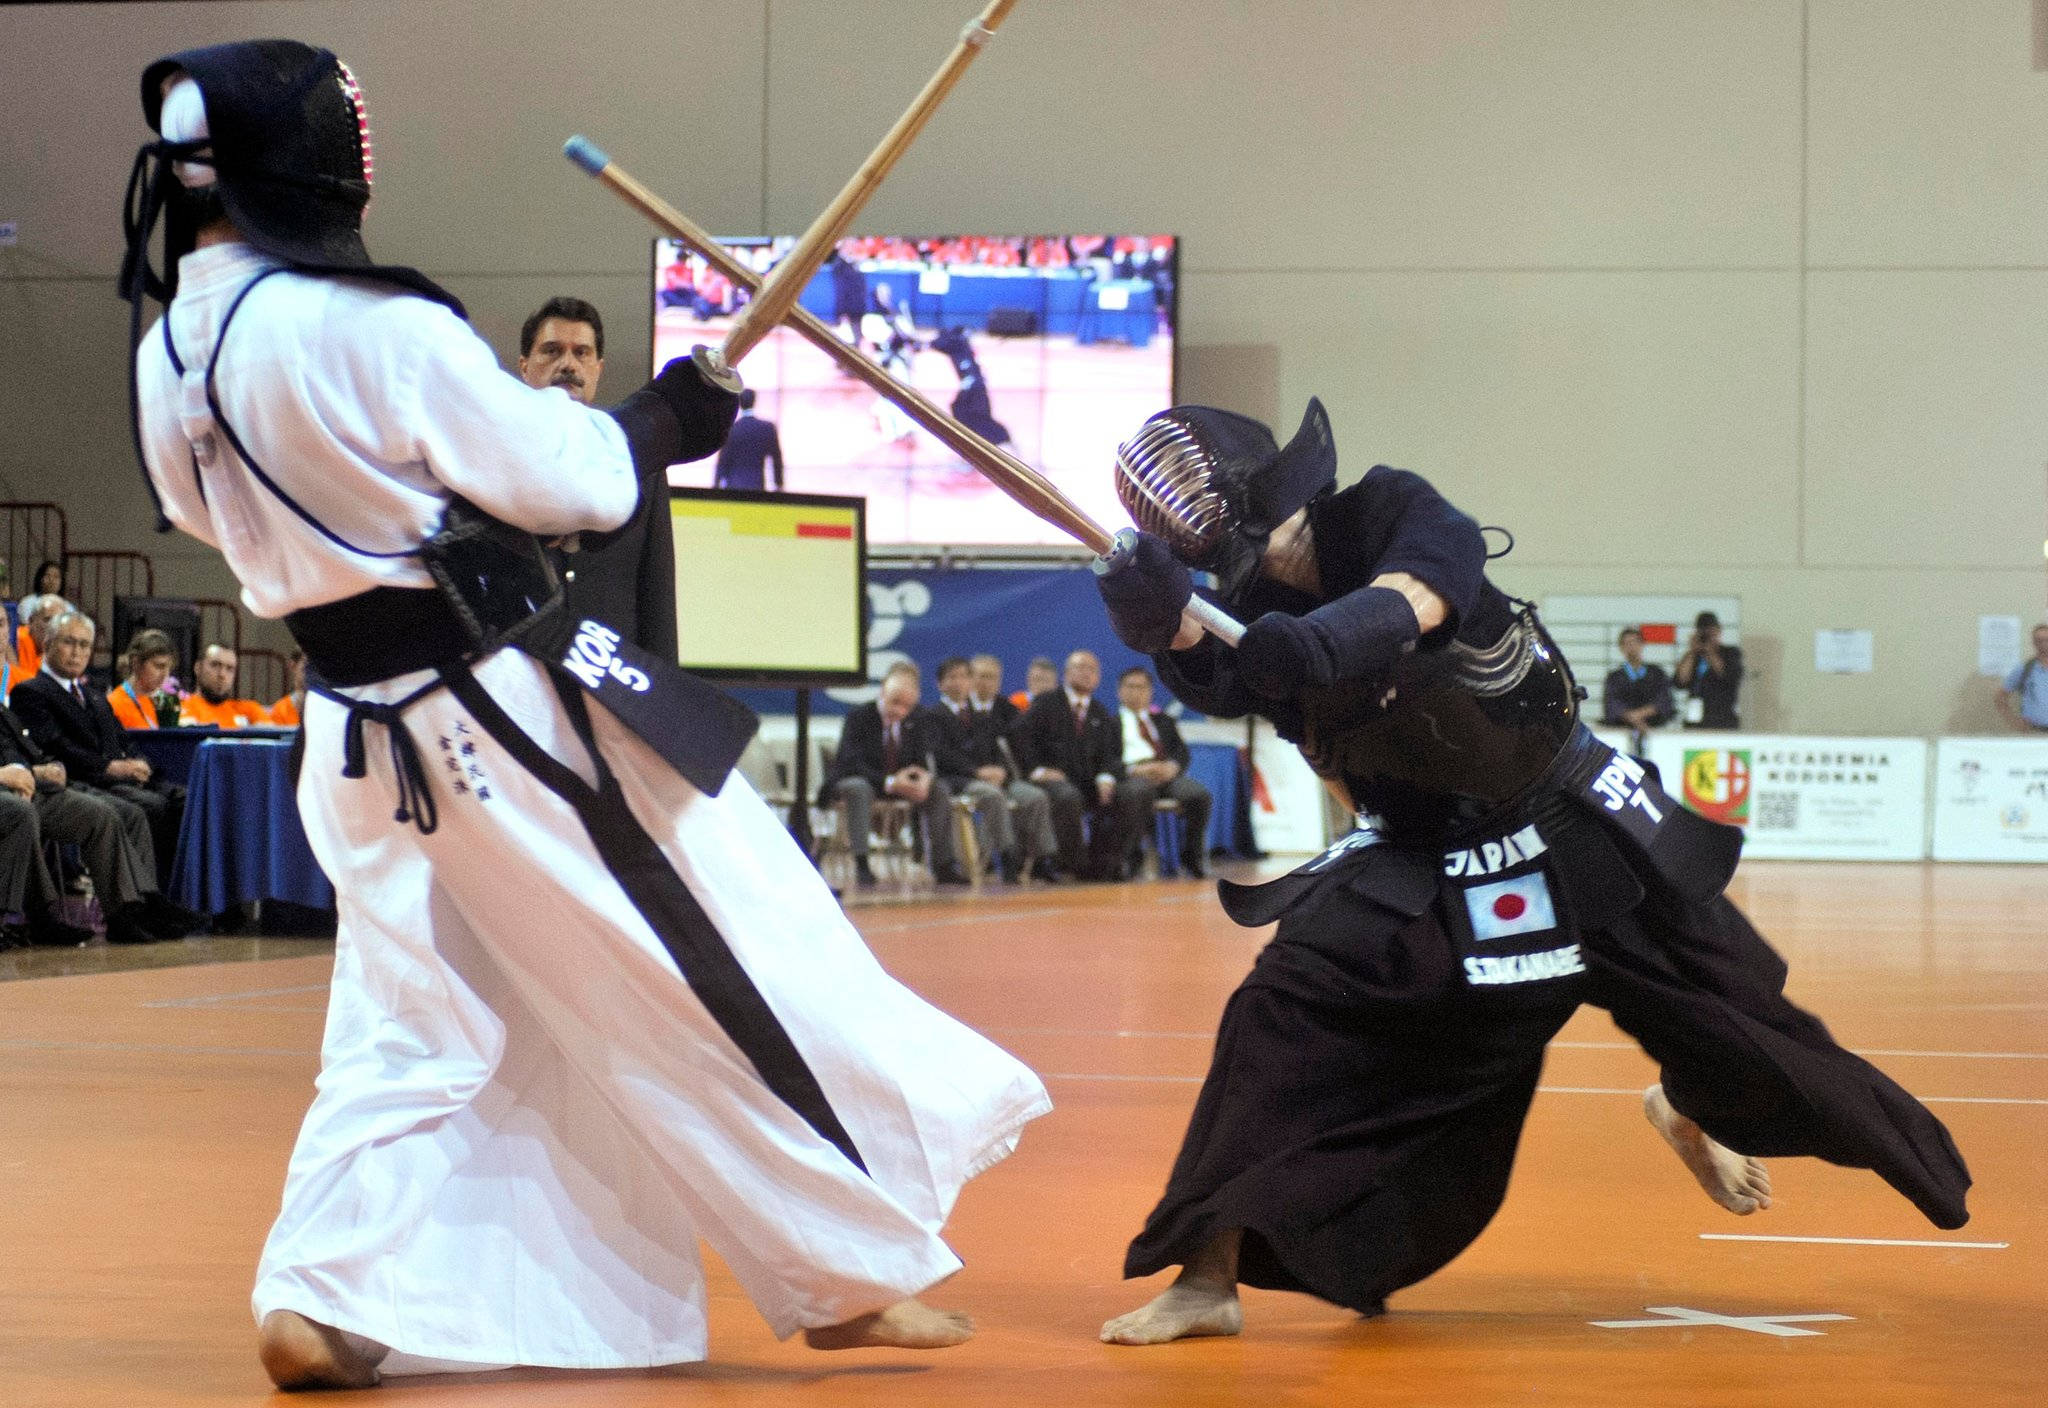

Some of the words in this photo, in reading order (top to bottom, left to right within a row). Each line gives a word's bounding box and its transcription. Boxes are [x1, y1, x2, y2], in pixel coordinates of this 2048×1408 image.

[563, 620, 620, 688] KOR
[609, 658, 650, 691] 5
[1757, 752, 1890, 766] ACCADEMIA
[1767, 770, 1879, 784] KODOKAN
[1591, 749, 1645, 811] JPN
[1629, 787, 1664, 823] 7
[1445, 824, 1548, 876] JAPAN
